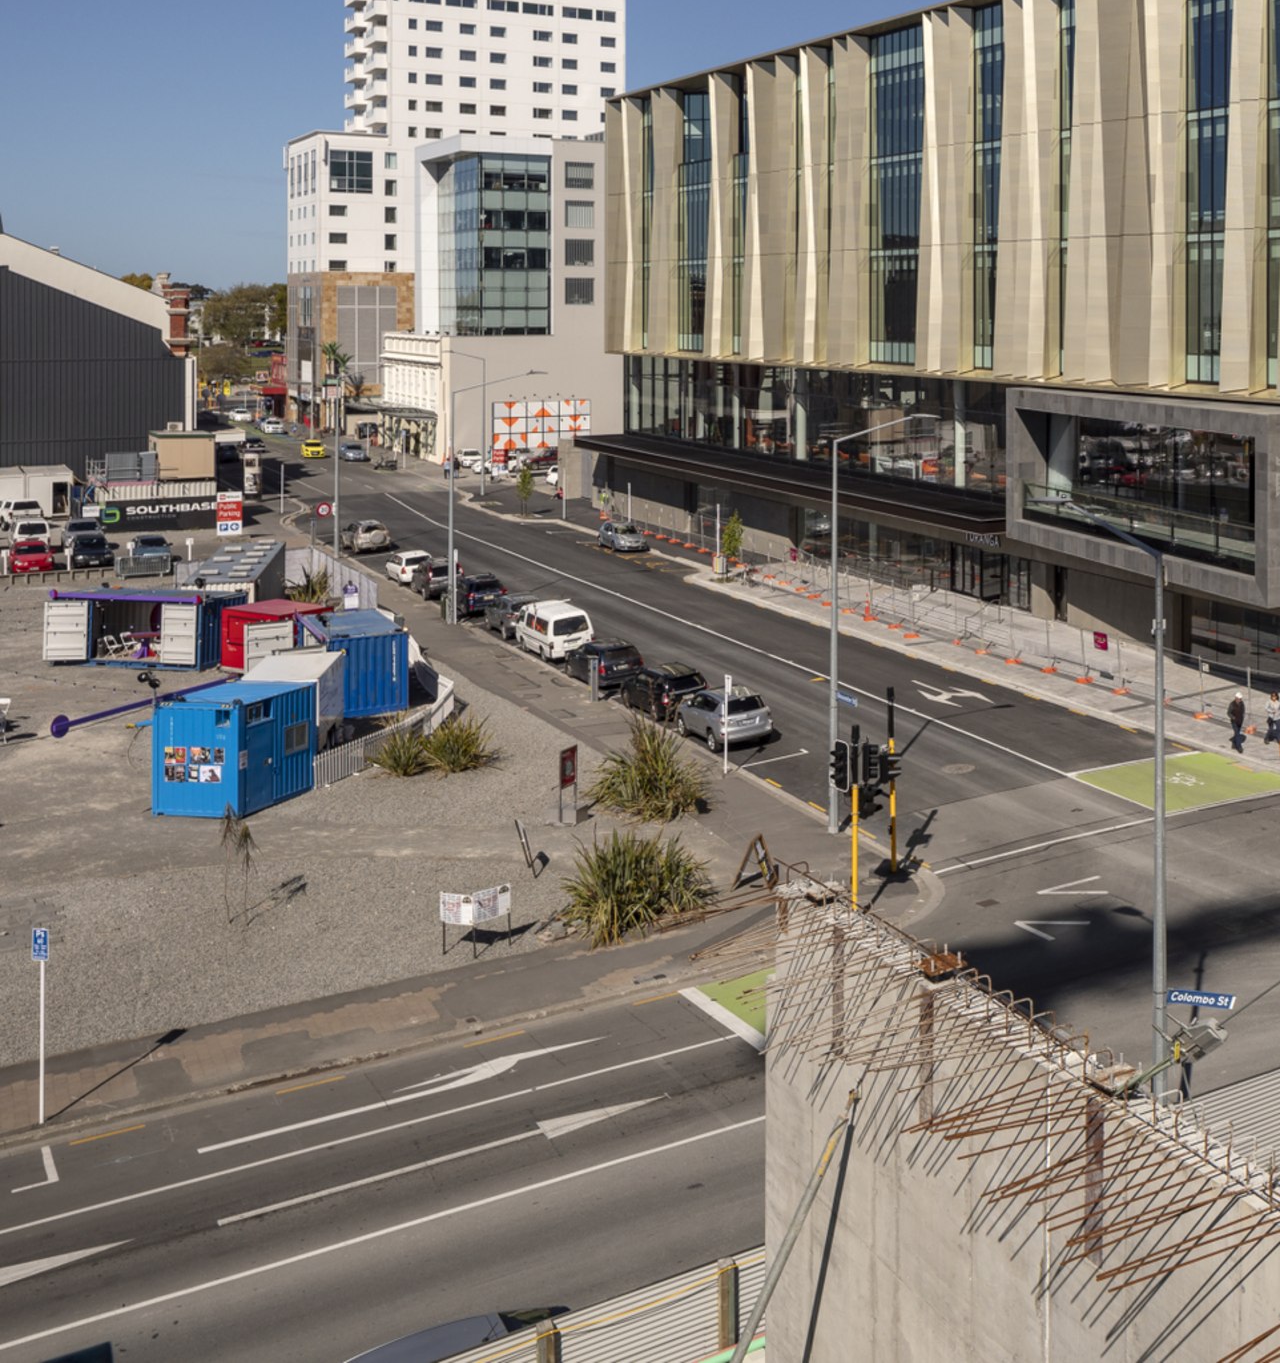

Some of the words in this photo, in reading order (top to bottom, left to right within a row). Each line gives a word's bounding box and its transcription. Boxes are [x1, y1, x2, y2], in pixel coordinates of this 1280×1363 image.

[219, 511, 241, 519] Parking
[1171, 991, 1215, 1005] Colombo
[1217, 996, 1229, 1006] St
